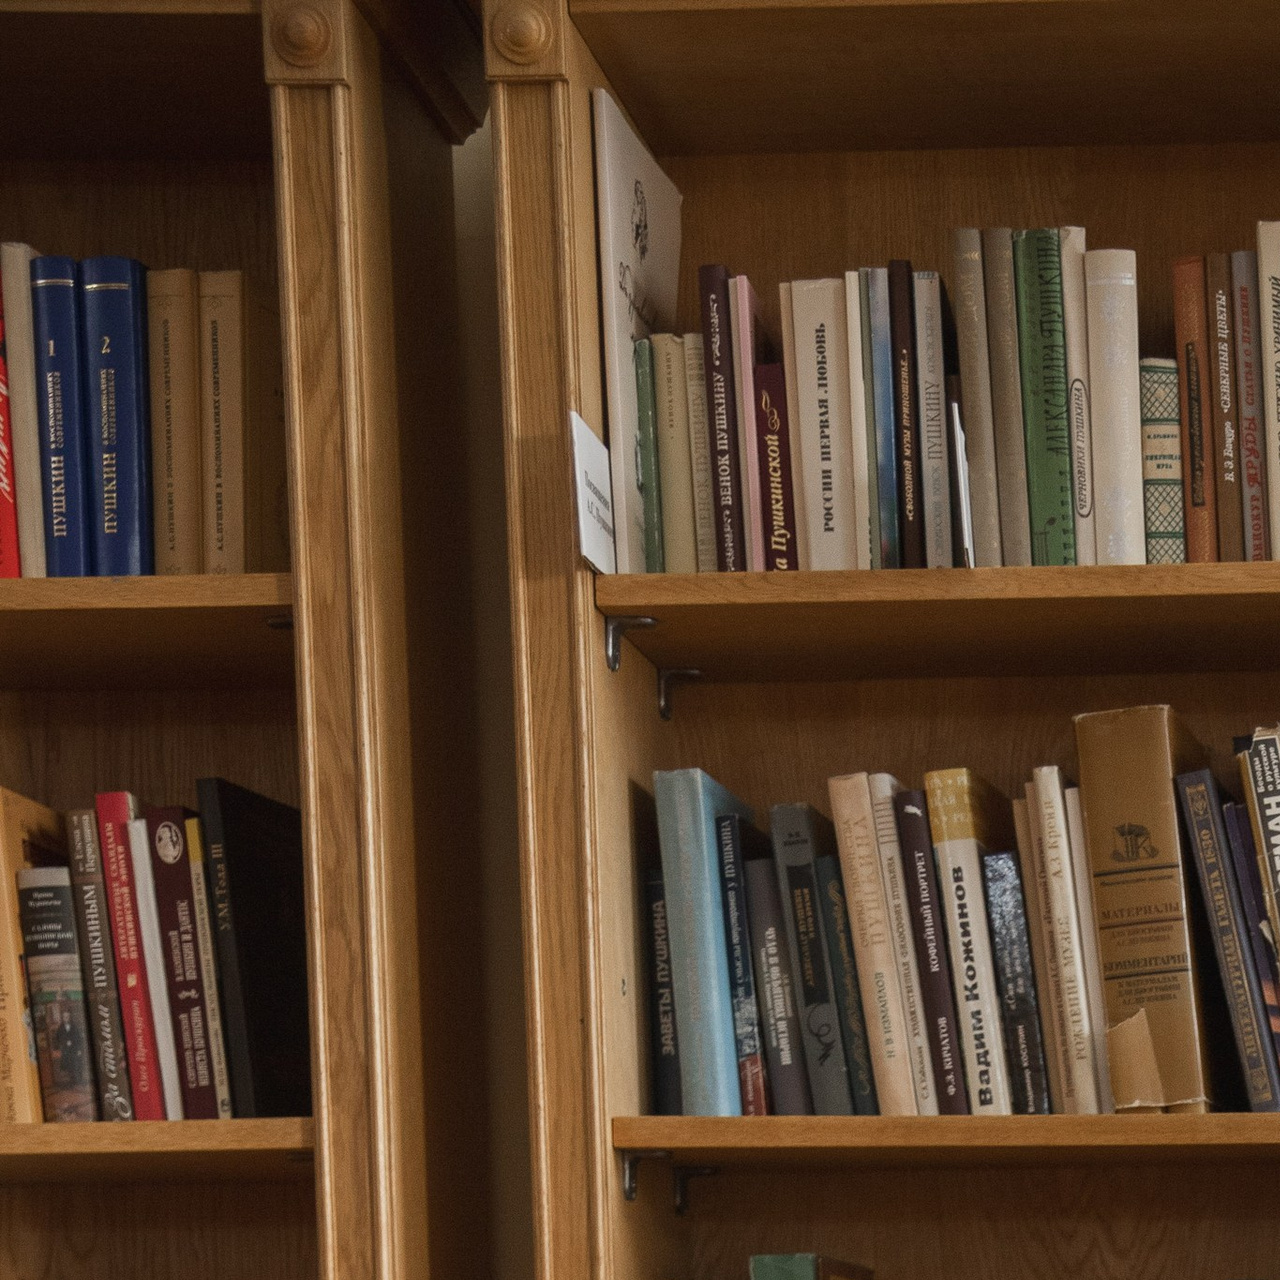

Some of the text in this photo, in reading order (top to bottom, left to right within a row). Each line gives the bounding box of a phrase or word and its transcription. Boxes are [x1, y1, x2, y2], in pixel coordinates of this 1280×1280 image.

[1036, 235, 1069, 456] АЛЕКСАНДРА ПУШКИНА
[1215, 289, 1229, 338] ЦВЕТЫ»
[1218, 342, 1231, 413] «СЕВЕРНЫЕ
[713, 372, 732, 505] ВЕНОК ПУШКИНУ
[815, 322, 835, 533] РОССИИ ПЕРВАЯ ЛЮБОВЬ
[903, 430, 911, 456] МУЗЫ
[925, 379, 943, 460] ПУШКИНУ
[1074, 387, 1087, 510] ЧЕРНОВИКИ ПУШКИНА
[1224, 420, 1235, 457] Вацуро
[1243, 416, 1260, 488] ТРУДЫ
[51, 455, 67, 538] ПУШКИН
[102, 452, 117, 534] ПУШКИН
[765, 434, 790, 551] Пушкинской
[1252, 756, 1265, 793] Беседы
[1259, 744, 1273, 781] русской
[721, 820, 736, 878] ПУШКИНА
[853, 815, 886, 946] ПУШКИНА
[1199, 828, 1218, 865] 1830
[82, 883, 108, 988] ПУШКИНЫМ
[914, 849, 941, 973] КОФЕЙНЫЙ ПОРТРЕТ
[1101, 902, 1180, 919] МАТЕРИАЛЫ
[1209, 870, 1230, 926] ГАЗЕТА
[652, 900, 675, 1055] ЗАВЕТЫ ПУШКИНА
[875, 972, 893, 1035] ИЗМАЙЛОВ
[950, 865, 994, 1106] Вадим Кожинов
[1063, 974, 1087, 1060] РОЖДЕНИЕ
[96, 1003, 119, 1079] столом
